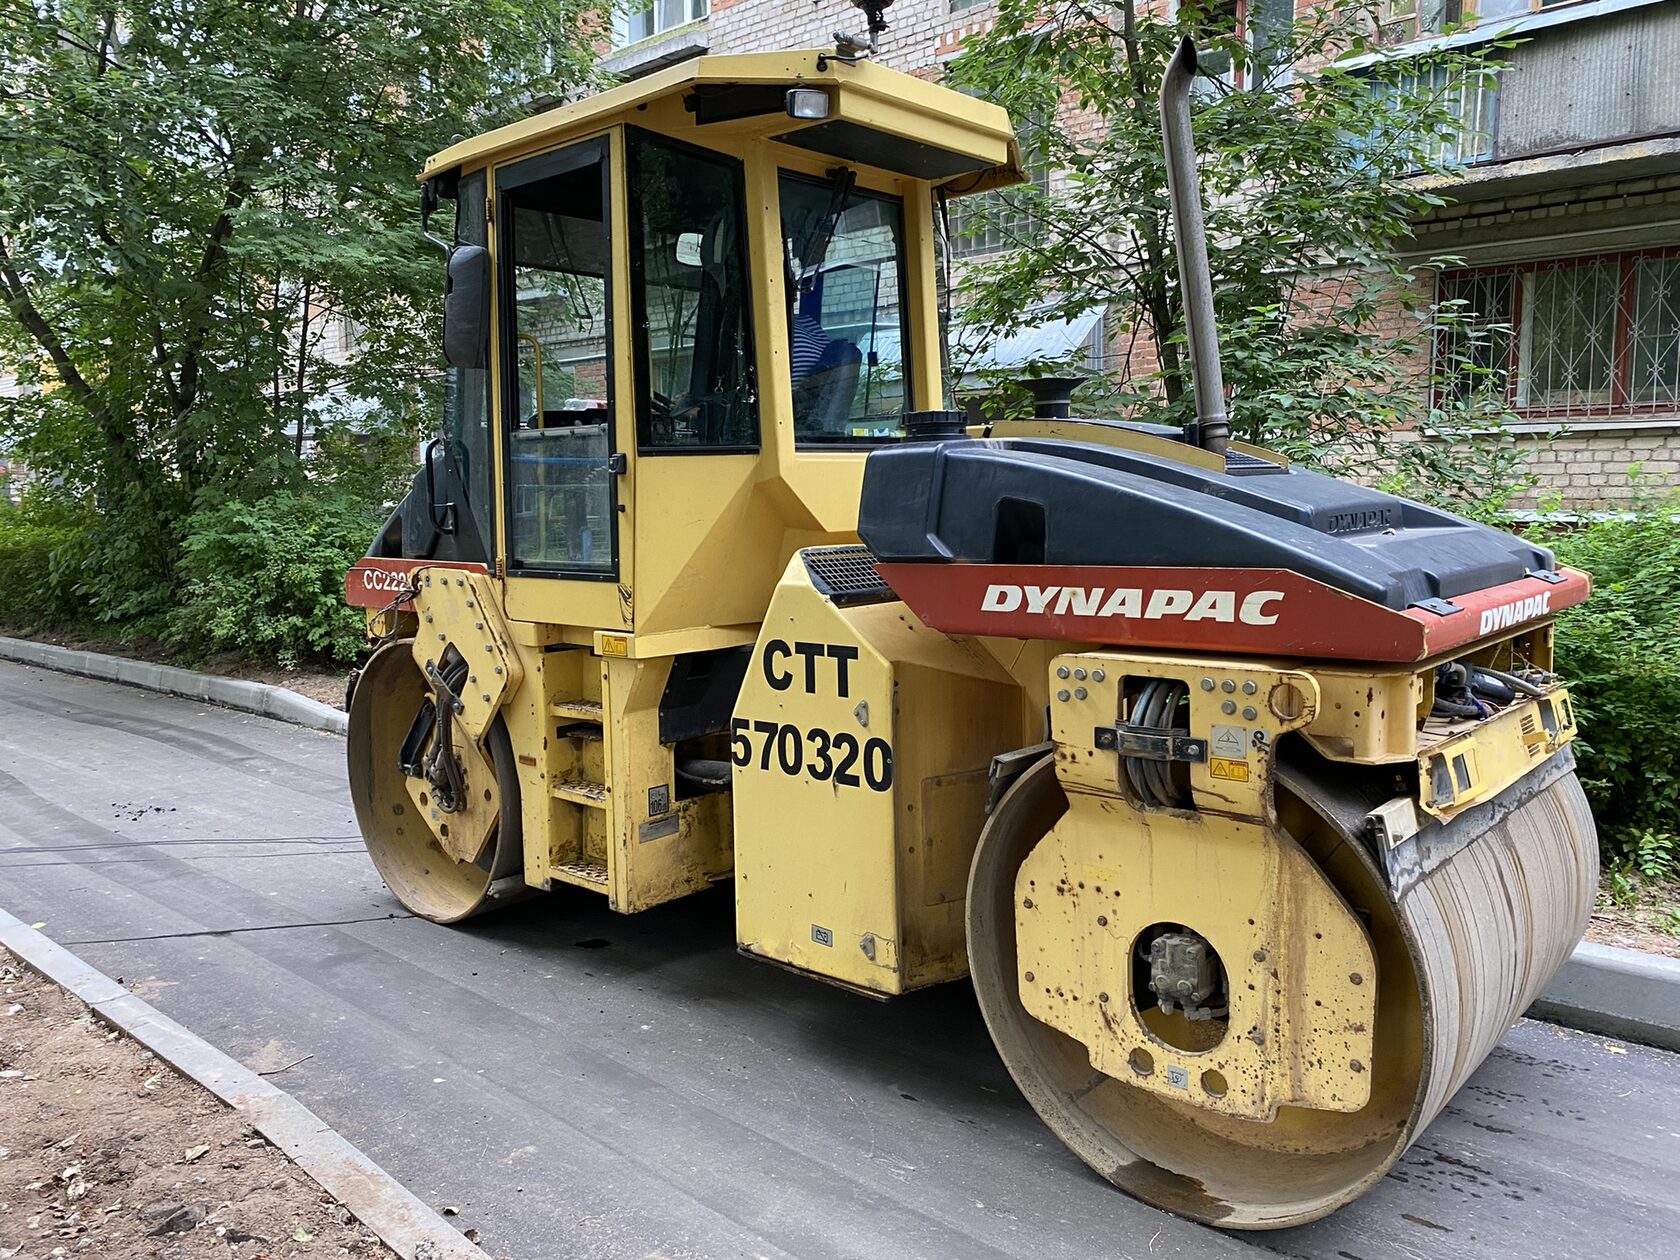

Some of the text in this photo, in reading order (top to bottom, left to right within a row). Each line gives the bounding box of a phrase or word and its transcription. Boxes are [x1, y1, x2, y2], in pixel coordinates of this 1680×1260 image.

[1328, 509, 1391, 533] DYNAPAC
[981, 584, 1285, 626] DYNAPAC
[1480, 591, 1551, 636] DYNAPAC
[731, 717, 893, 792] 570320
